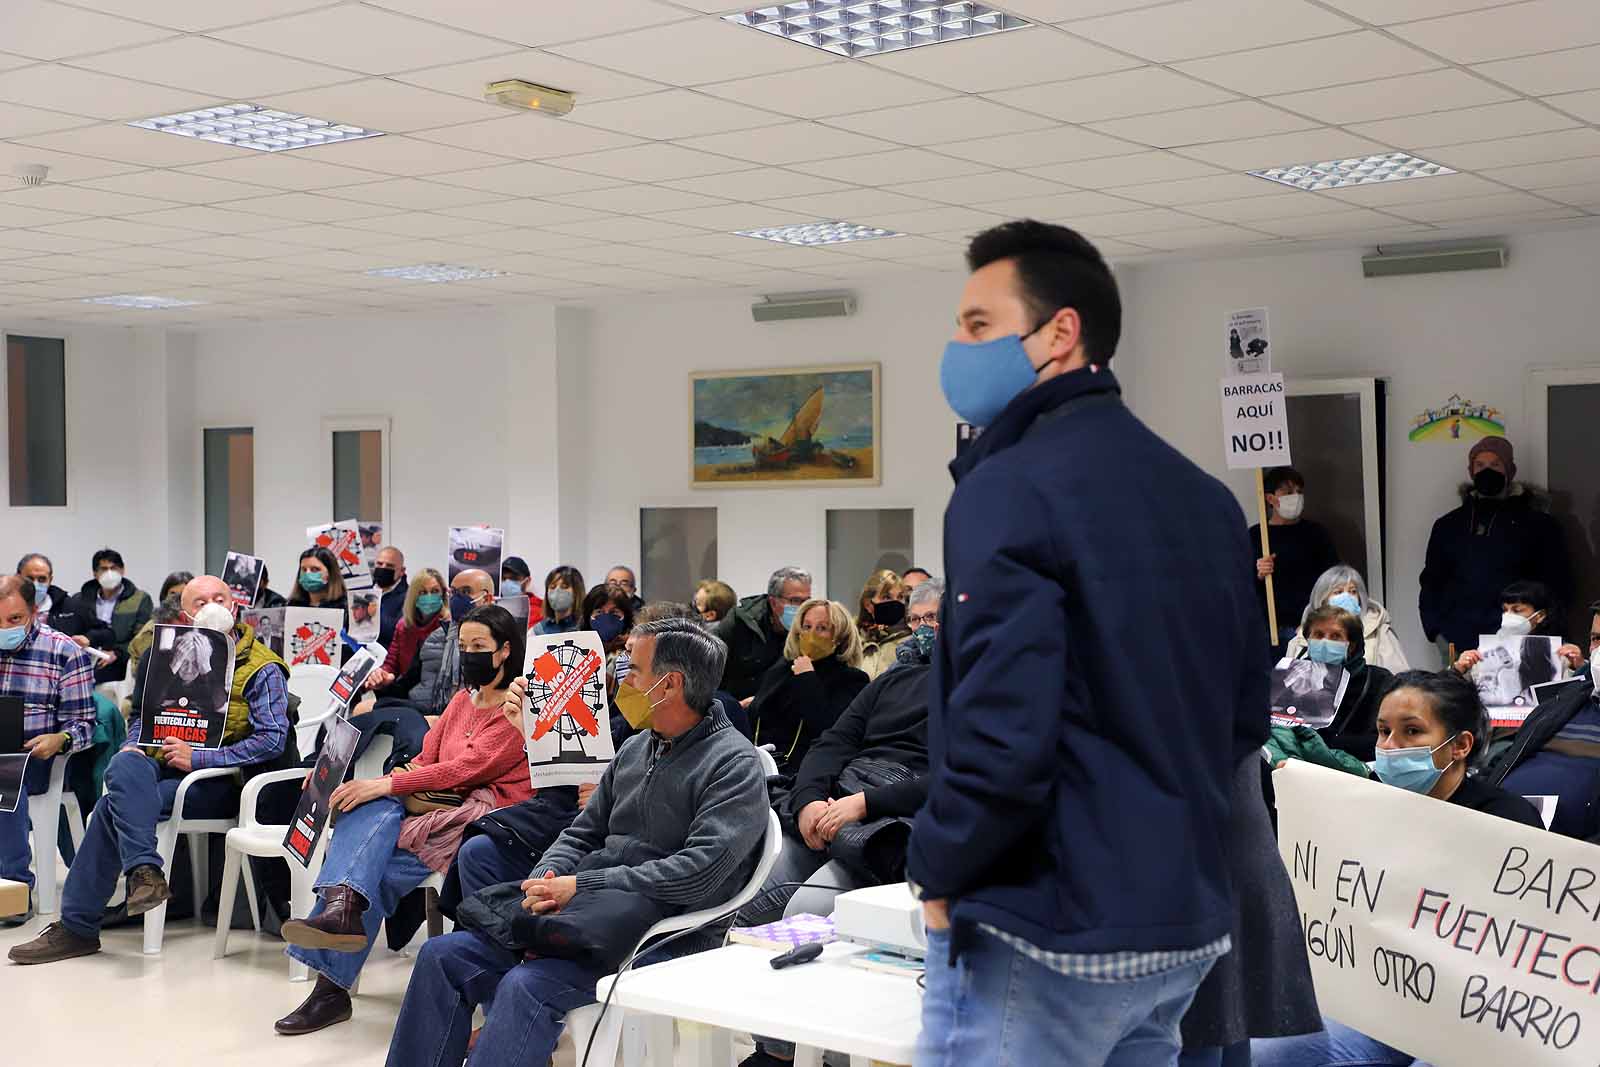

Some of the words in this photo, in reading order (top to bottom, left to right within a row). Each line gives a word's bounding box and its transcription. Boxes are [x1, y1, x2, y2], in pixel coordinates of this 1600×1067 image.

[1224, 382, 1283, 397] BARRACAS
[1236, 401, 1274, 419] AQUÍ
[1231, 430, 1283, 453] NO!!
[545, 654, 593, 711] FUENTECILLAS
[153, 725, 208, 742] BARRACAS
[154, 716, 196, 727] FUENTECILLAS
[196, 719, 209, 729] SIN
[1294, 840, 1318, 890] NI
[1336, 859, 1385, 912] EN
[1493, 846, 1600, 921] BAR
[1303, 907, 1355, 969] GÚN
[1374, 947, 1436, 1004] OTRO
[1460, 975, 1580, 1049] BARRIO
